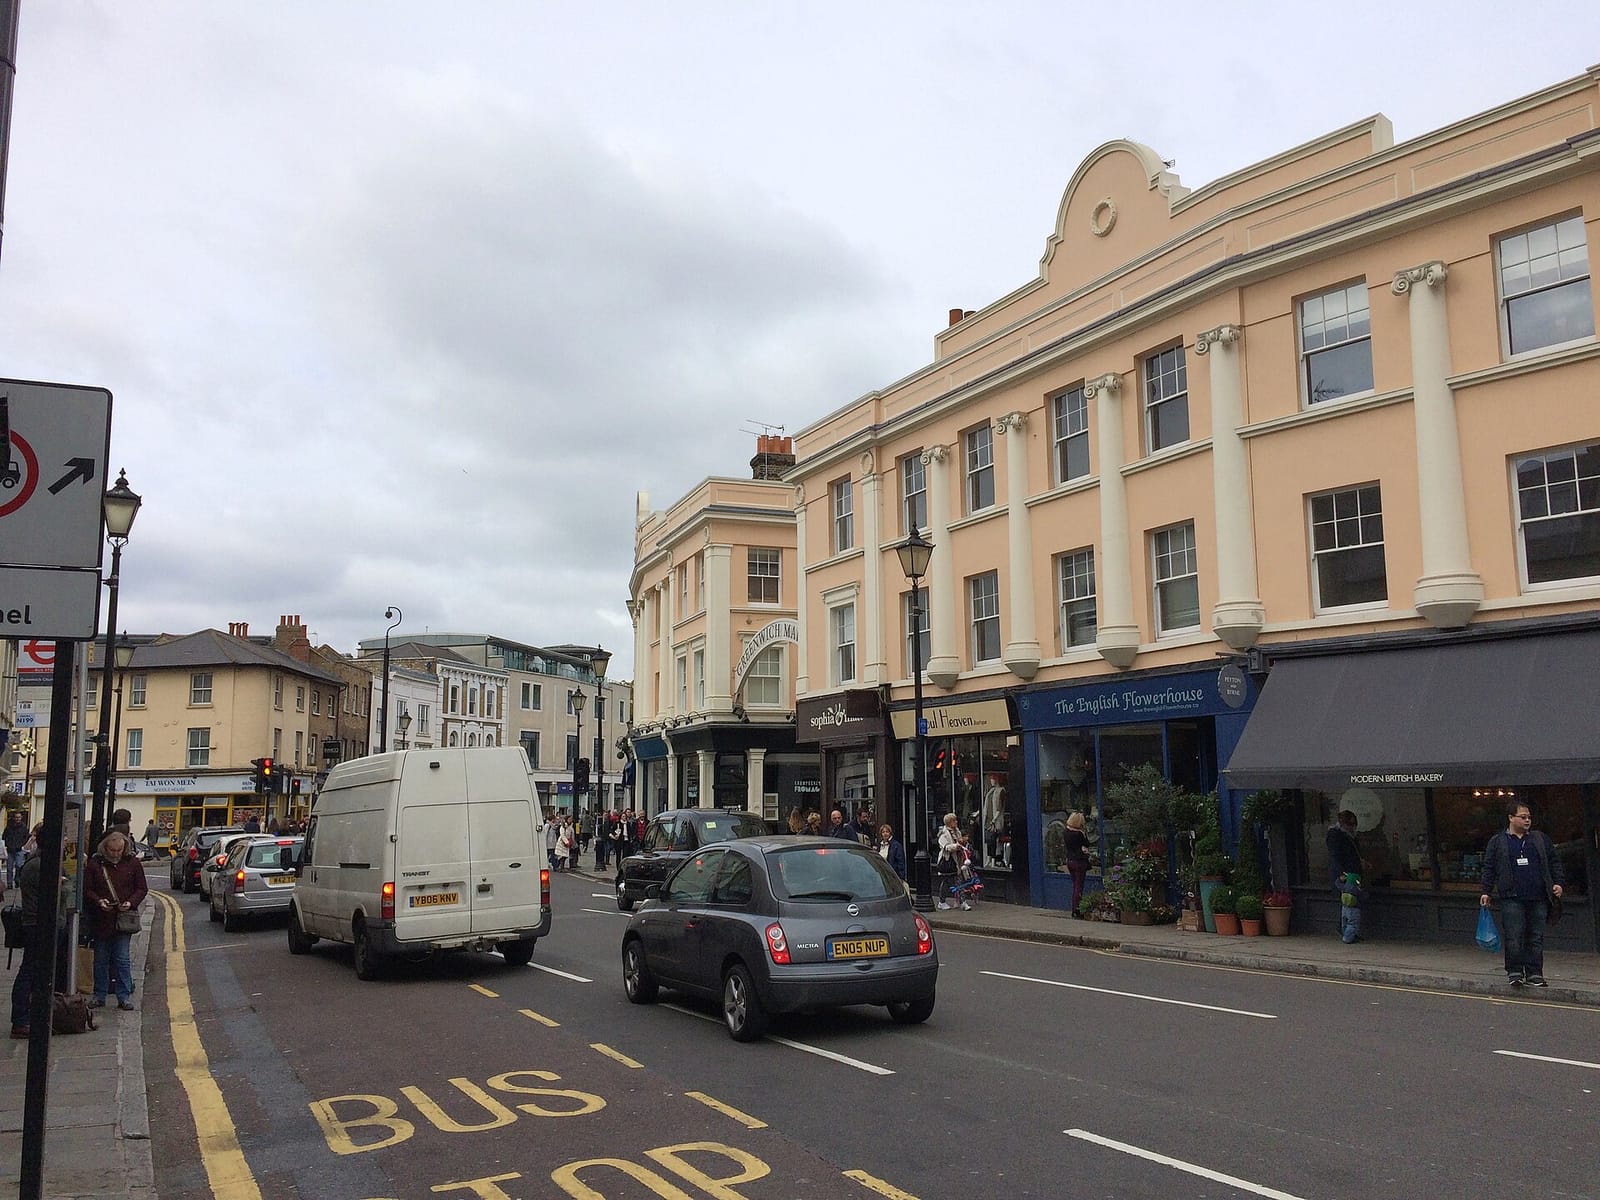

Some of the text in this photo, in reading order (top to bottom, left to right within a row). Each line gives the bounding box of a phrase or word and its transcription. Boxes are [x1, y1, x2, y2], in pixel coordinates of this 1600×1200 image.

[0, 605, 32, 624] el
[736, 623, 780, 677] GREENWICH
[1054, 687, 1205, 716] The English Flowerhouse
[810, 711, 835, 730] sophia
[939, 708, 974, 729] Heaven
[1350, 773, 1444, 783] MODERN BRITISH BAKERY
[415, 892, 458, 905] YB06 KNV
[834, 941, 885, 956] EN05 NUP
[308, 1070, 608, 1156] BUS
[358, 1141, 772, 1200] TOP
